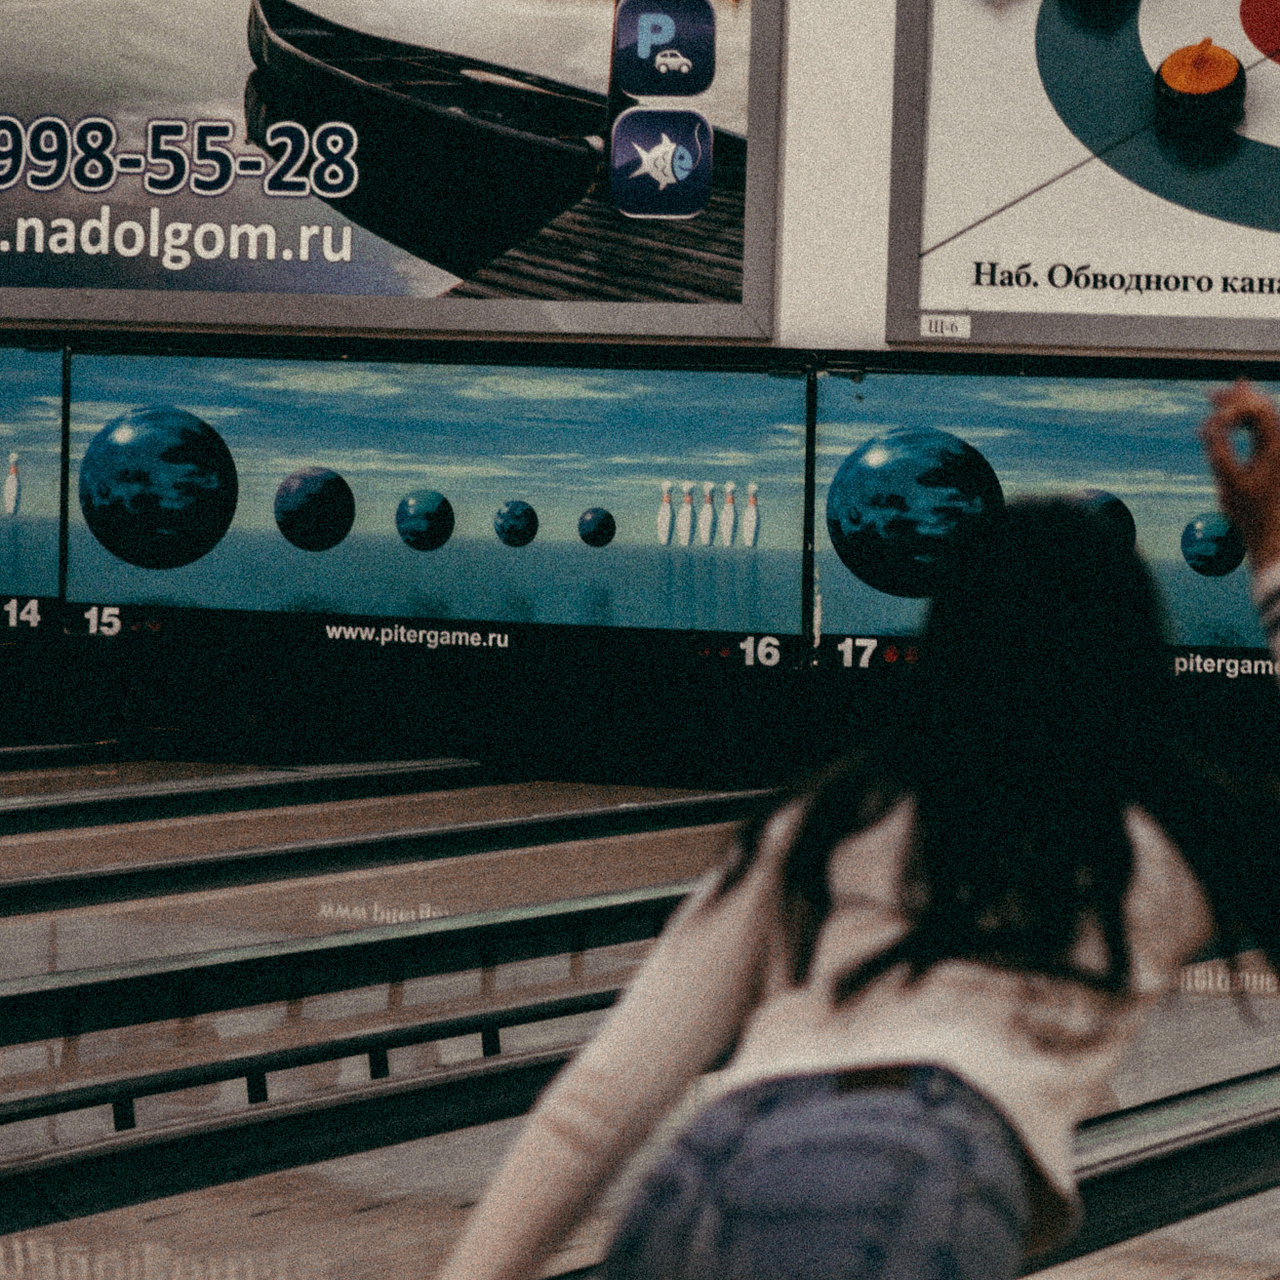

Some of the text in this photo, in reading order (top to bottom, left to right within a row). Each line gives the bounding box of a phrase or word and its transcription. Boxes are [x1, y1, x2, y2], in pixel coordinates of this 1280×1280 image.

[0, 116, 359, 198] 998-55-28
[972, 261, 1039, 289] Наб.
[1047, 265, 1213, 297] Обводного
[3, 598, 41, 629] 14
[84, 606, 122, 636] 15
[325, 621, 510, 650] www.pitergame.ru
[739, 635, 781, 667] 16
[837, 637, 878, 669] 17
